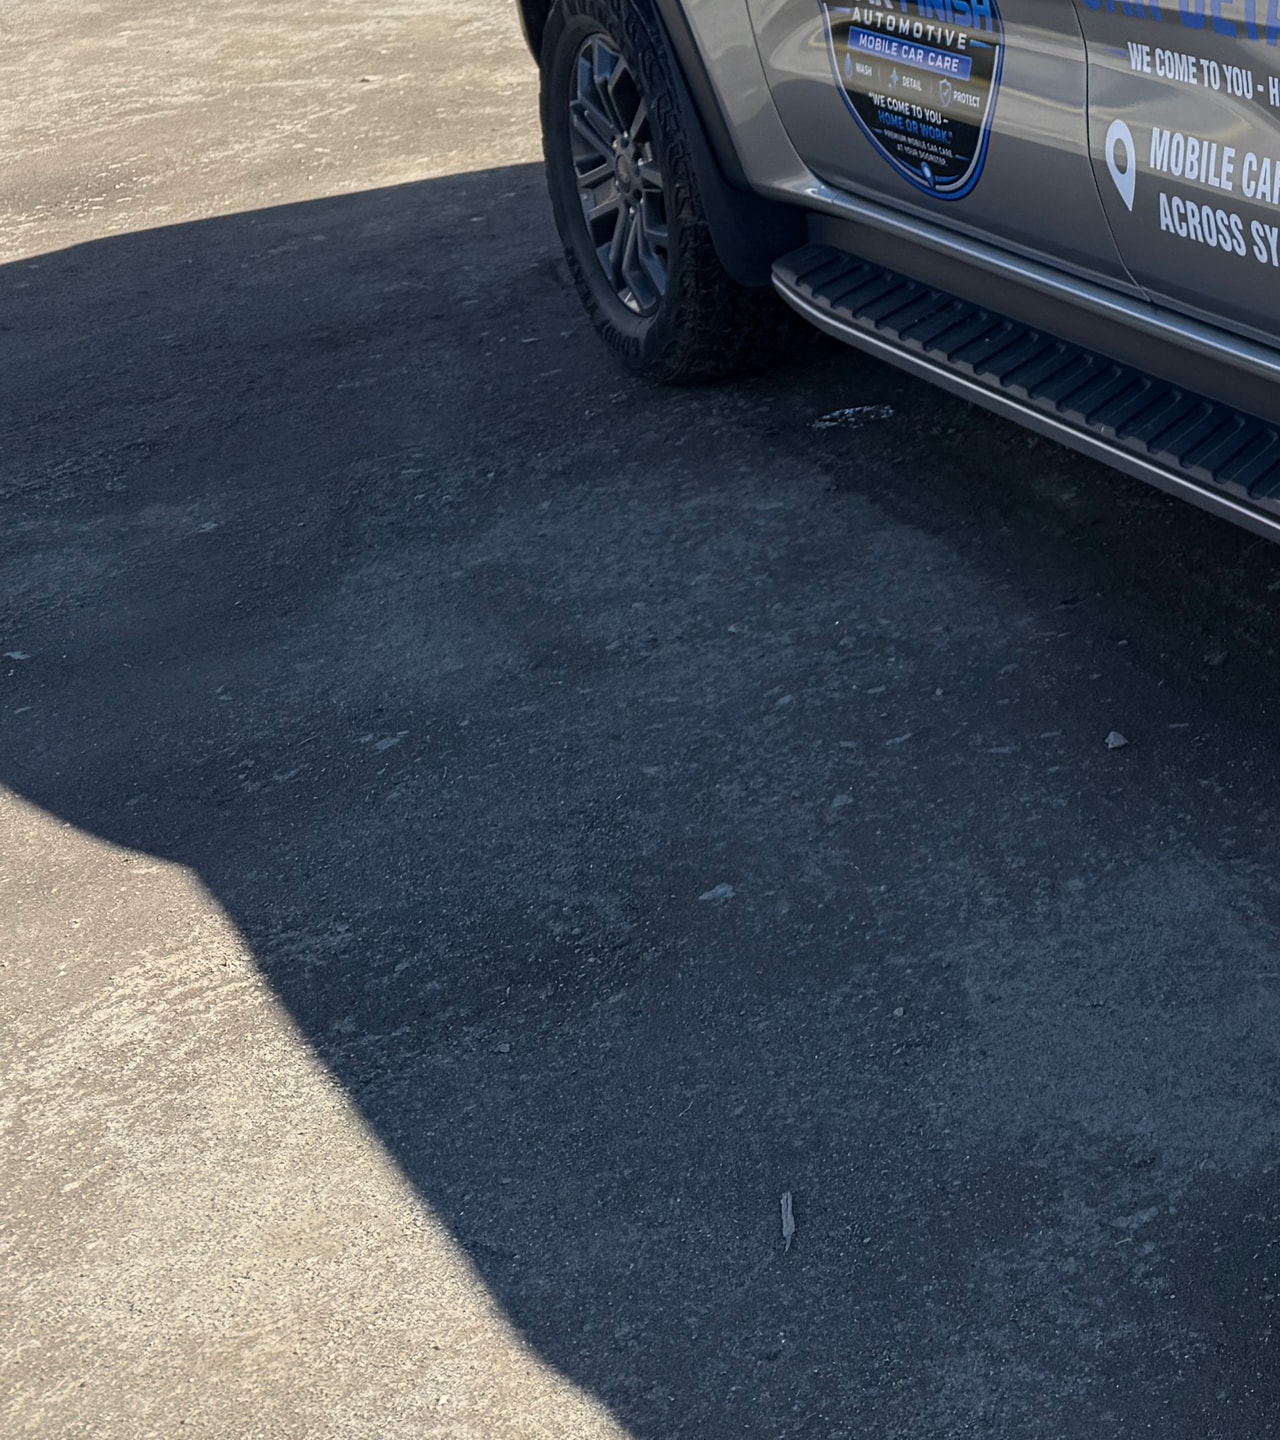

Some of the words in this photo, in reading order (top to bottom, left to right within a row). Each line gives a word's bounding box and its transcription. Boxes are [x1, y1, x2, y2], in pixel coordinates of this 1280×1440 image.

[852, 7, 967, 50] AUTOMOTIVE
[859, 33, 898, 56] MOBILE
[901, 45, 923, 63] CAR
[928, 53, 959, 72] CARE
[1127, 41, 1152, 73] WE
[1155, 47, 1198, 85] COME
[1200, 59, 1221, 90] TO
[1222, 64, 1253, 100] YOU
[878, 110, 904, 129] HOME
[905, 119, 918, 134] OR
[887, 97, 909, 114] COME
[911, 105, 922, 118] TO
[924, 108, 941, 124] YOU
[1149, 127, 1236, 192] MOBILE
[1159, 192, 1247, 257] ACROSS
